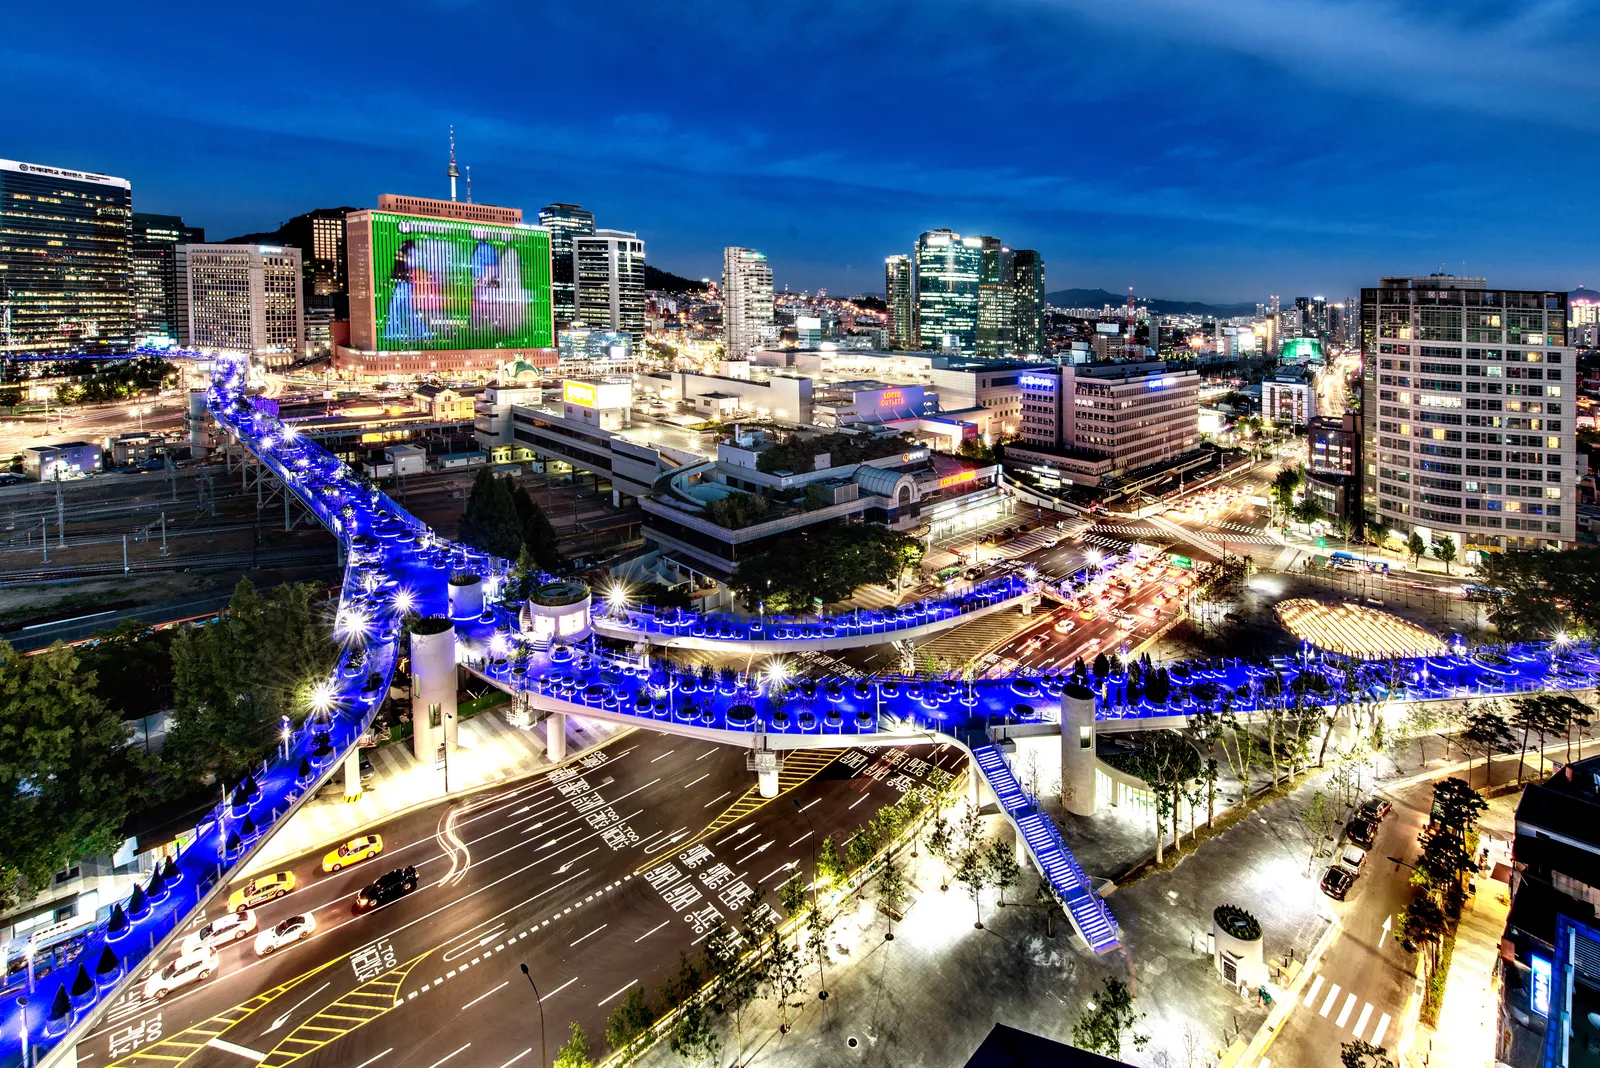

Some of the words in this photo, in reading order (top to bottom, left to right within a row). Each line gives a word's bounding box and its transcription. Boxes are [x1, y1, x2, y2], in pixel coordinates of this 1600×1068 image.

[880, 397, 905, 406] OUTLETS
[883, 391, 901, 399] LOTTE
[557, 777, 591, 798] 숭례문
[570, 791, 607, 814] 서소문
[584, 806, 621, 830] 충정로
[599, 822, 640, 852] 충정로역
[678, 843, 716, 869] 청파동
[643, 861, 683, 891] 삼거리
[698, 862, 736, 890] 청파동
[662, 881, 704, 912] 삼거리
[717, 880, 755, 911] 만리동
[683, 901, 725, 934] 공덕동
[349, 938, 398, 983] 충정로역
[108, 1012, 163, 1059] 충정로
